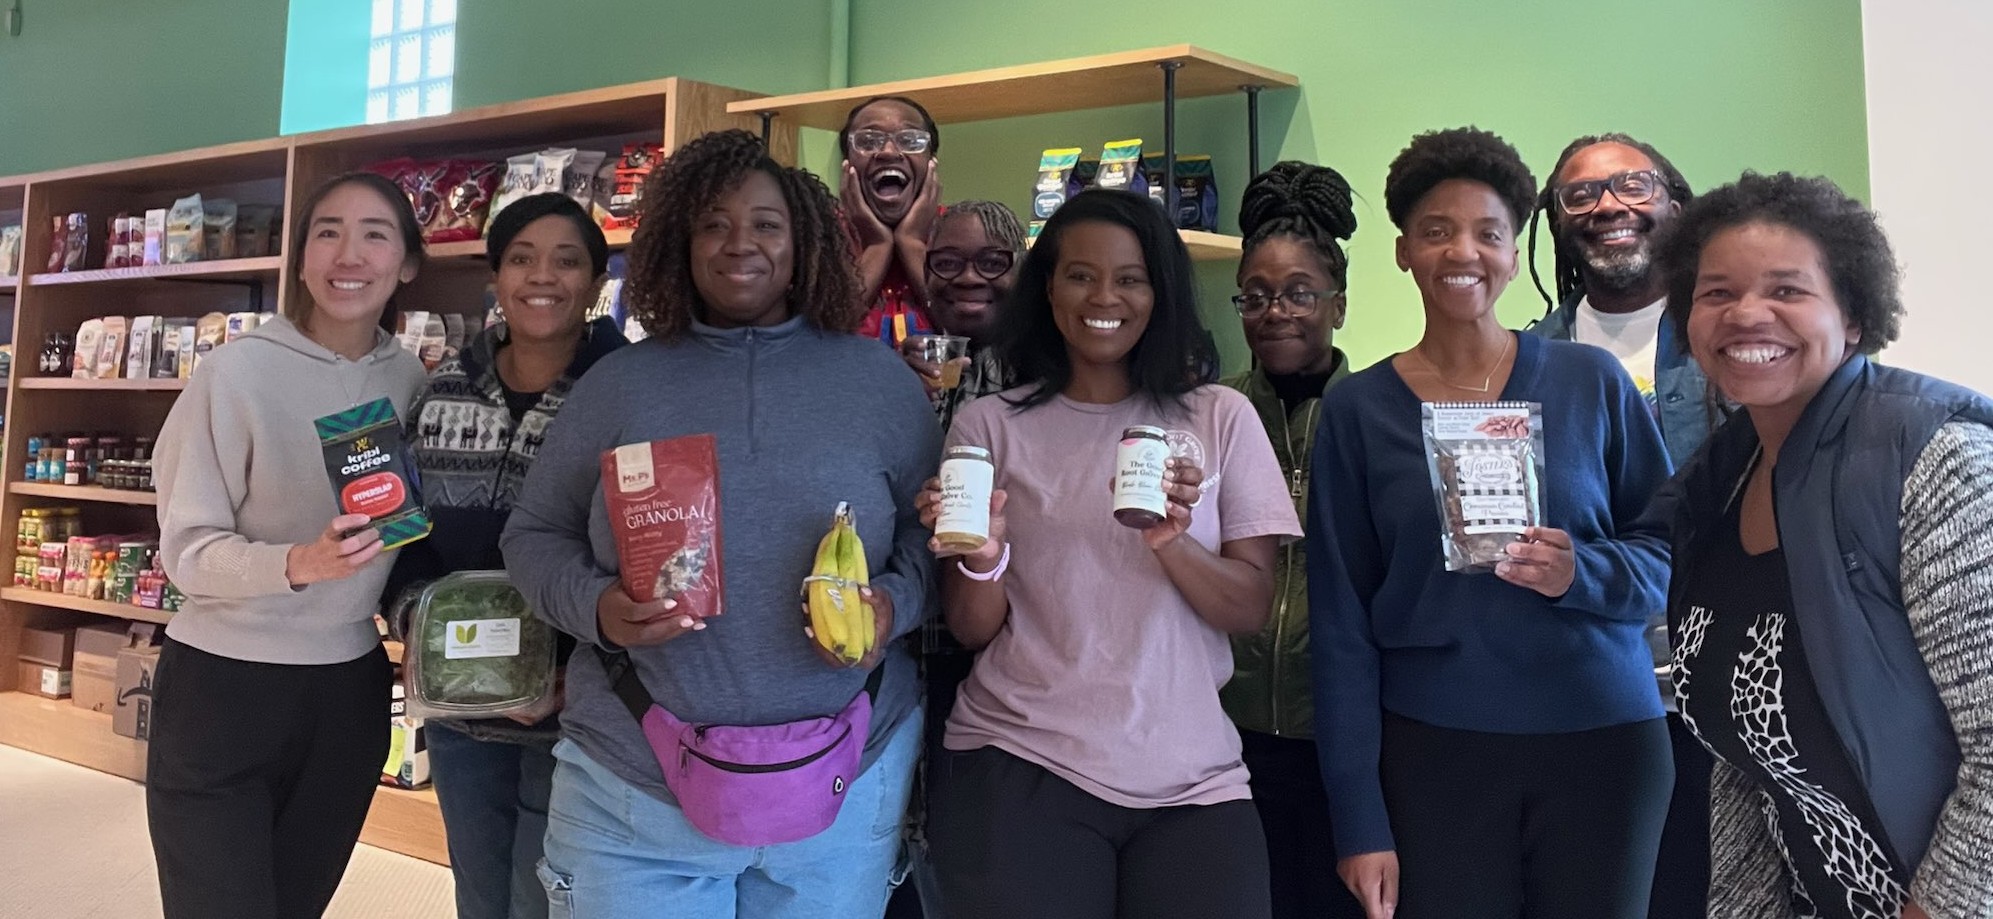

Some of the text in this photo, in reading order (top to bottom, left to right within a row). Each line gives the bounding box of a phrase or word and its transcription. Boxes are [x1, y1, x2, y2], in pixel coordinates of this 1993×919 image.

[341, 453, 391, 475] coffee
[347, 446, 380, 464] kribi
[1130, 460, 1145, 468] The
[945, 484, 965, 493] Good
[623, 499, 672, 518] gluten free
[626, 504, 699, 529] GRANOLA
